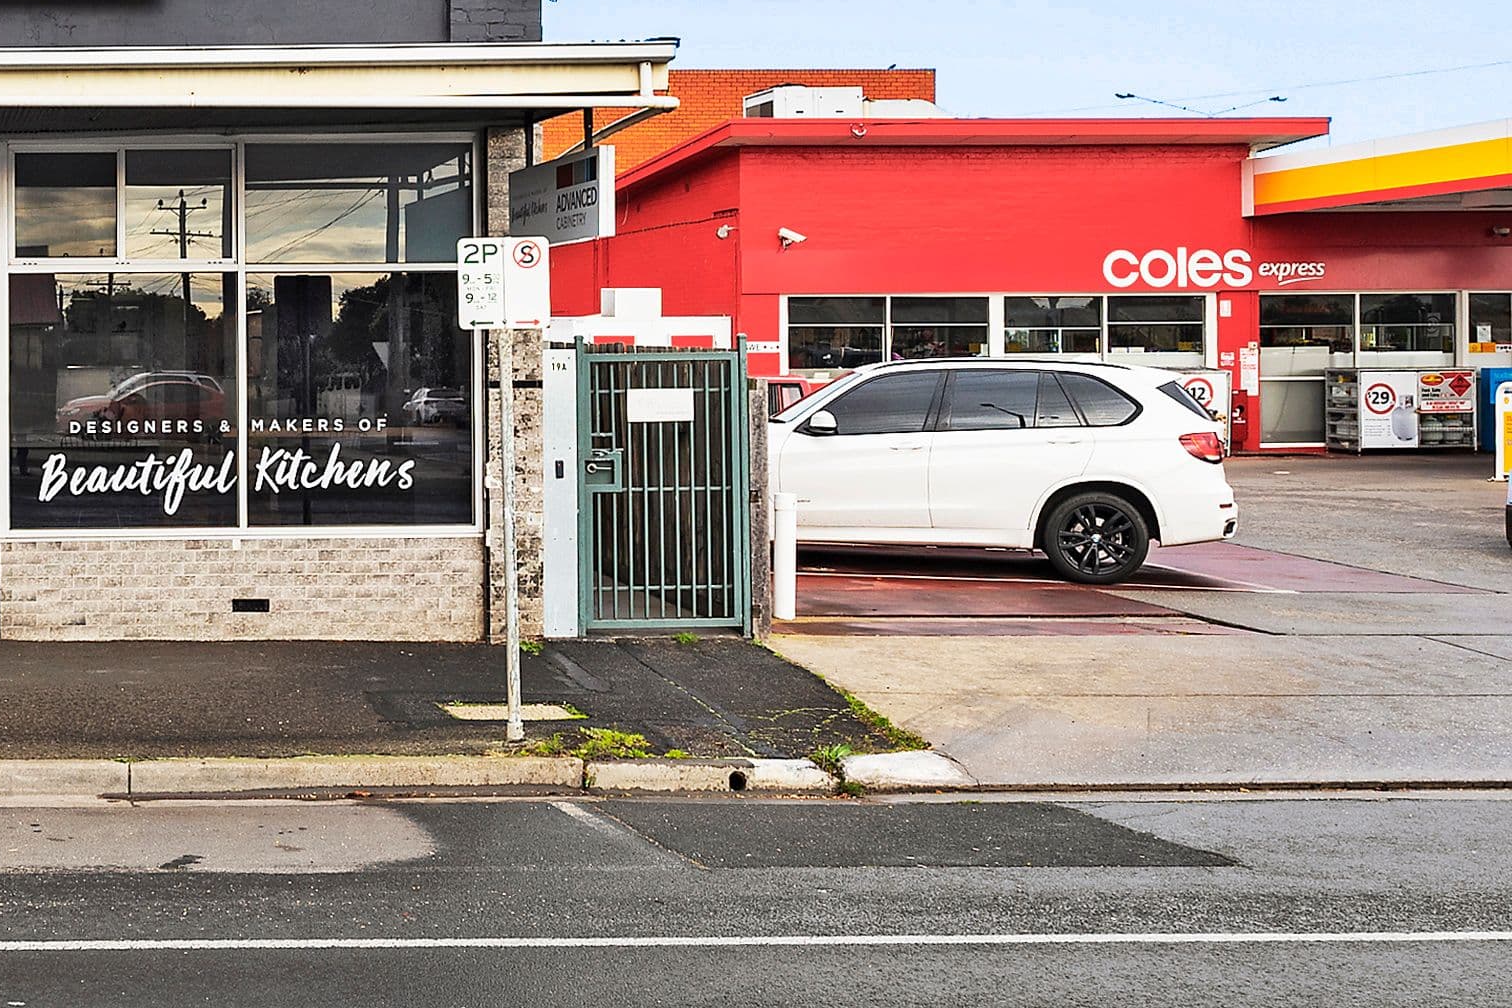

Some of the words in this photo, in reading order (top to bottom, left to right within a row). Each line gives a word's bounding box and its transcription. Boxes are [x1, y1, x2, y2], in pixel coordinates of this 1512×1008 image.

[556, 186, 598, 213] ADVANCED
[463, 243, 498, 264] 2P
[520, 245, 535, 264] S
[1102, 247, 1253, 288] coles
[1258, 261, 1326, 281] express
[70, 419, 204, 434] DESIGNERS
[219, 419, 232, 433] &
[251, 419, 345, 432] MAKERS
[358, 418, 388, 432] OF
[38, 448, 239, 516] Beautiful
[254, 442, 416, 494] Kitchens
